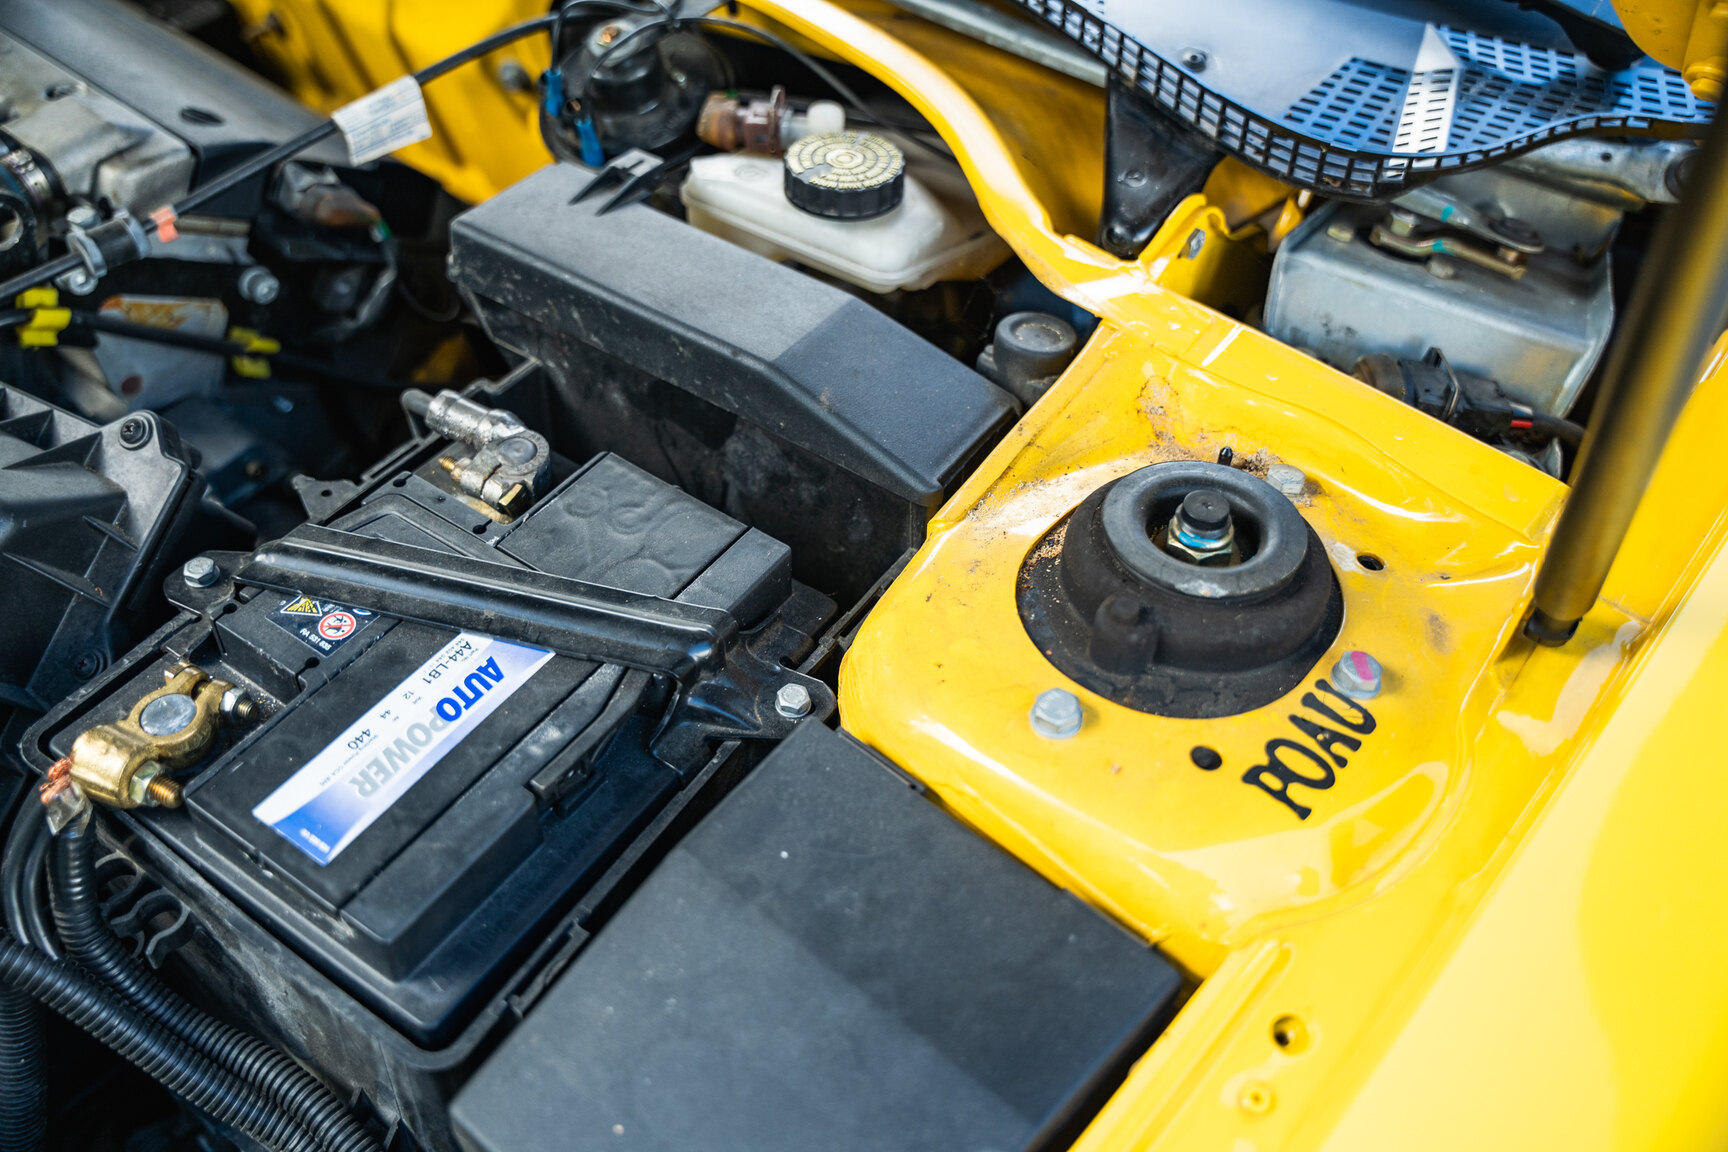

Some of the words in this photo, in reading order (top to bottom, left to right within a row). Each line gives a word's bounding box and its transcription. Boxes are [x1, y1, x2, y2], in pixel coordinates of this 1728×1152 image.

[422, 640, 472, 684] A44-LB1
[403, 689, 414, 700] 12
[380, 709, 391, 719] 44
[349, 655, 506, 799] AUTOPOWER
[347, 728, 371, 750] 440
